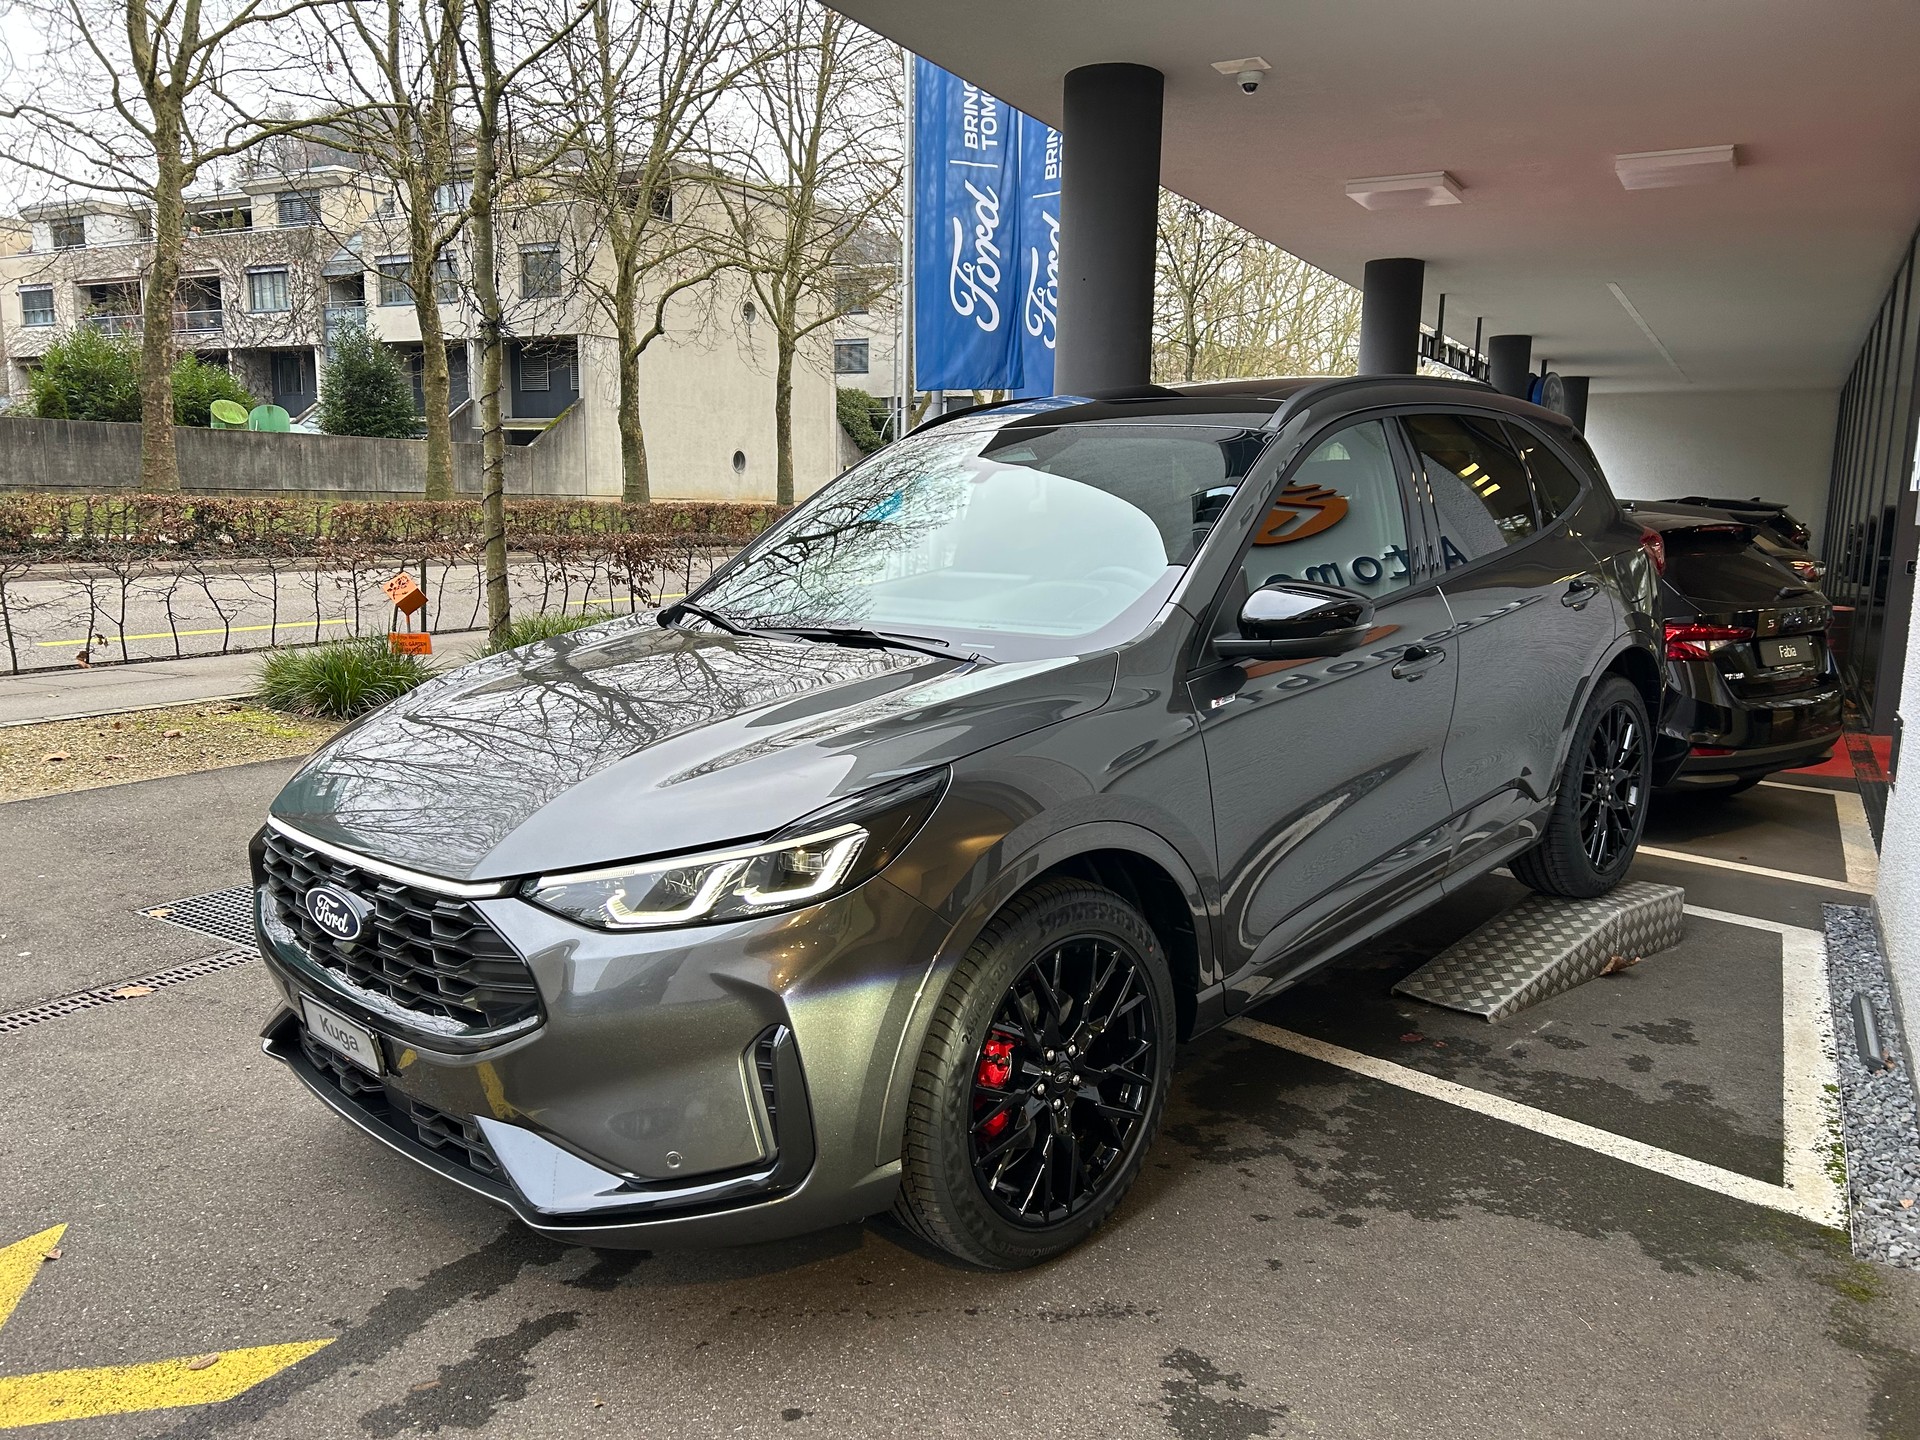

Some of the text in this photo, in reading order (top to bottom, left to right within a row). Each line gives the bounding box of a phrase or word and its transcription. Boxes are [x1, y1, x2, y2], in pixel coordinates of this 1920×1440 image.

[981, 89, 998, 151] TOM
[949, 179, 1000, 332] Ford
[1778, 644, 1798, 658] Fabia
[314, 893, 349, 935] Ford
[318, 1013, 360, 1054] Kuga
